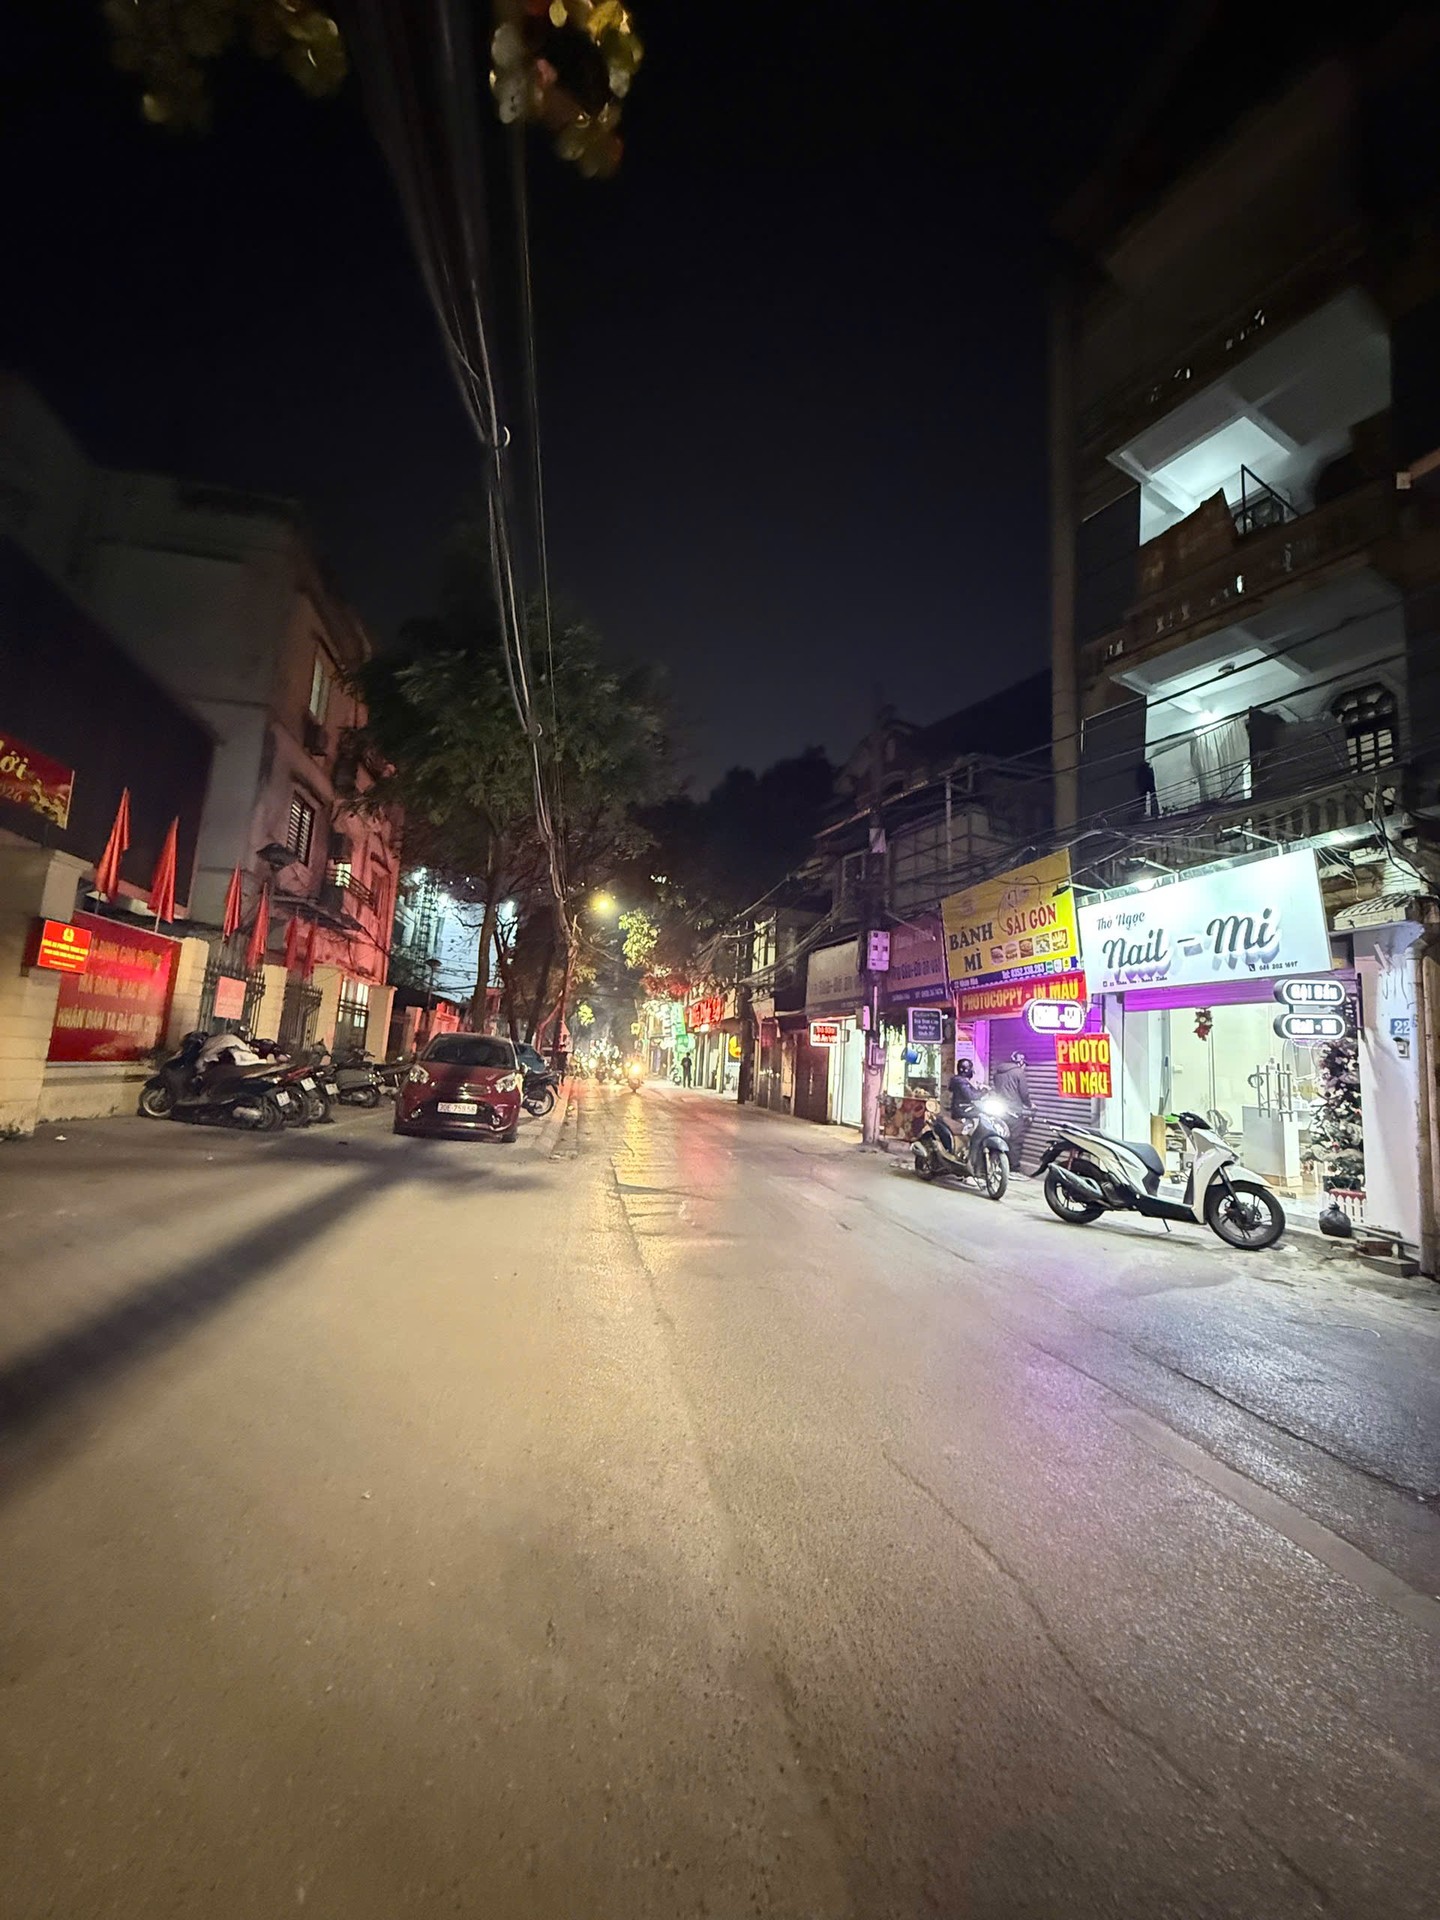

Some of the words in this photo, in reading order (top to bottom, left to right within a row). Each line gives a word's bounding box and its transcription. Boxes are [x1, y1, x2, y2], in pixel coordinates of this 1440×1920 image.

[0, 740, 29, 780] ới
[1006, 910, 1027, 936] SÀI
[1029, 901, 1057, 929] GÒN
[1116, 912, 1146, 930] Ngọc
[949, 922, 994, 951] BÁNH
[1102, 928, 1168, 969] Nail
[1206, 907, 1274, 954] Mi
[964, 948, 982, 972] MÌ
[1033, 983, 1046, 1001] IN
[1049, 977, 1079, 1001] MÀU
[1057, 1039, 1109, 1064] PHOTO
[1062, 1071, 1077, 1094] IN
